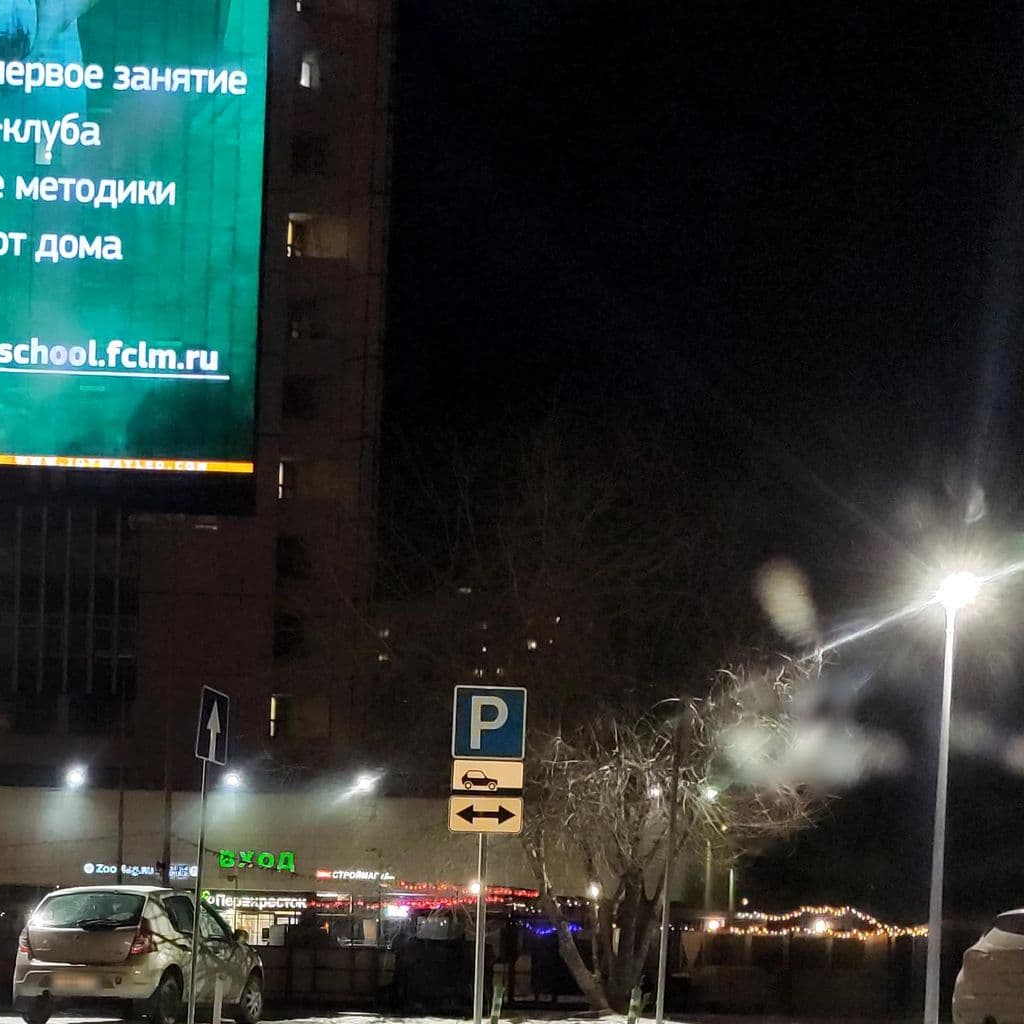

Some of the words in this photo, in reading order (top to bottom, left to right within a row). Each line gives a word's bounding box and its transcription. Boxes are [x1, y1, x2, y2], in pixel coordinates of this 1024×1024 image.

[113, 66, 248, 95] занятие
[16, 172, 177, 206] методики
[35, 233, 123, 263] дома
[470, 695, 509, 750] P
[218, 849, 295, 873] ВХОД
